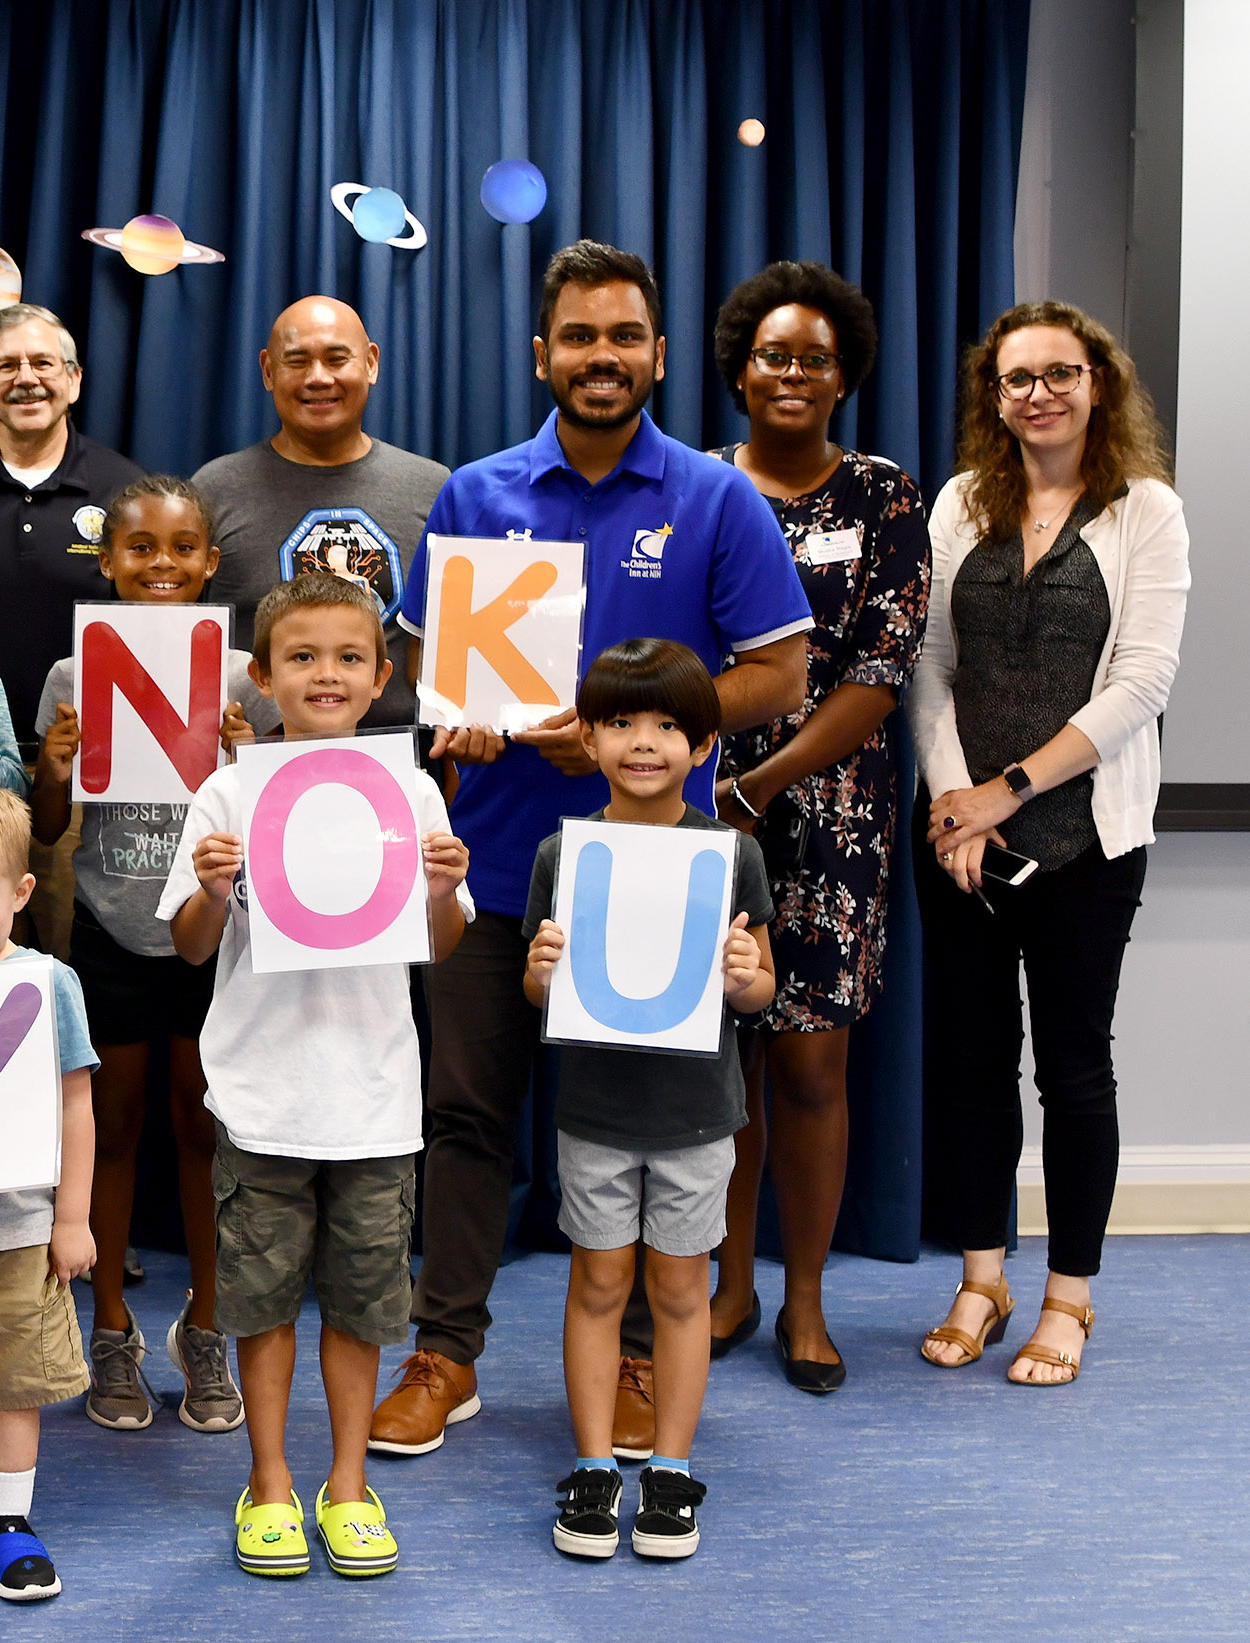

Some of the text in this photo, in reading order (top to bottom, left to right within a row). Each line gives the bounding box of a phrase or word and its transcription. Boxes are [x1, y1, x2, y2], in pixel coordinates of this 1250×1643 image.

[289, 522, 310, 547] CHIPS
[363, 518, 388, 546] SPACE
[630, 559, 661, 569] Children's
[650, 570, 661, 578] NIH
[434, 555, 561, 711] K
[79, 618, 223, 795] N
[105, 803, 162, 821] THOSE
[134, 832, 180, 851] WAIT
[249, 748, 419, 950] O
[571, 841, 727, 1034] U
